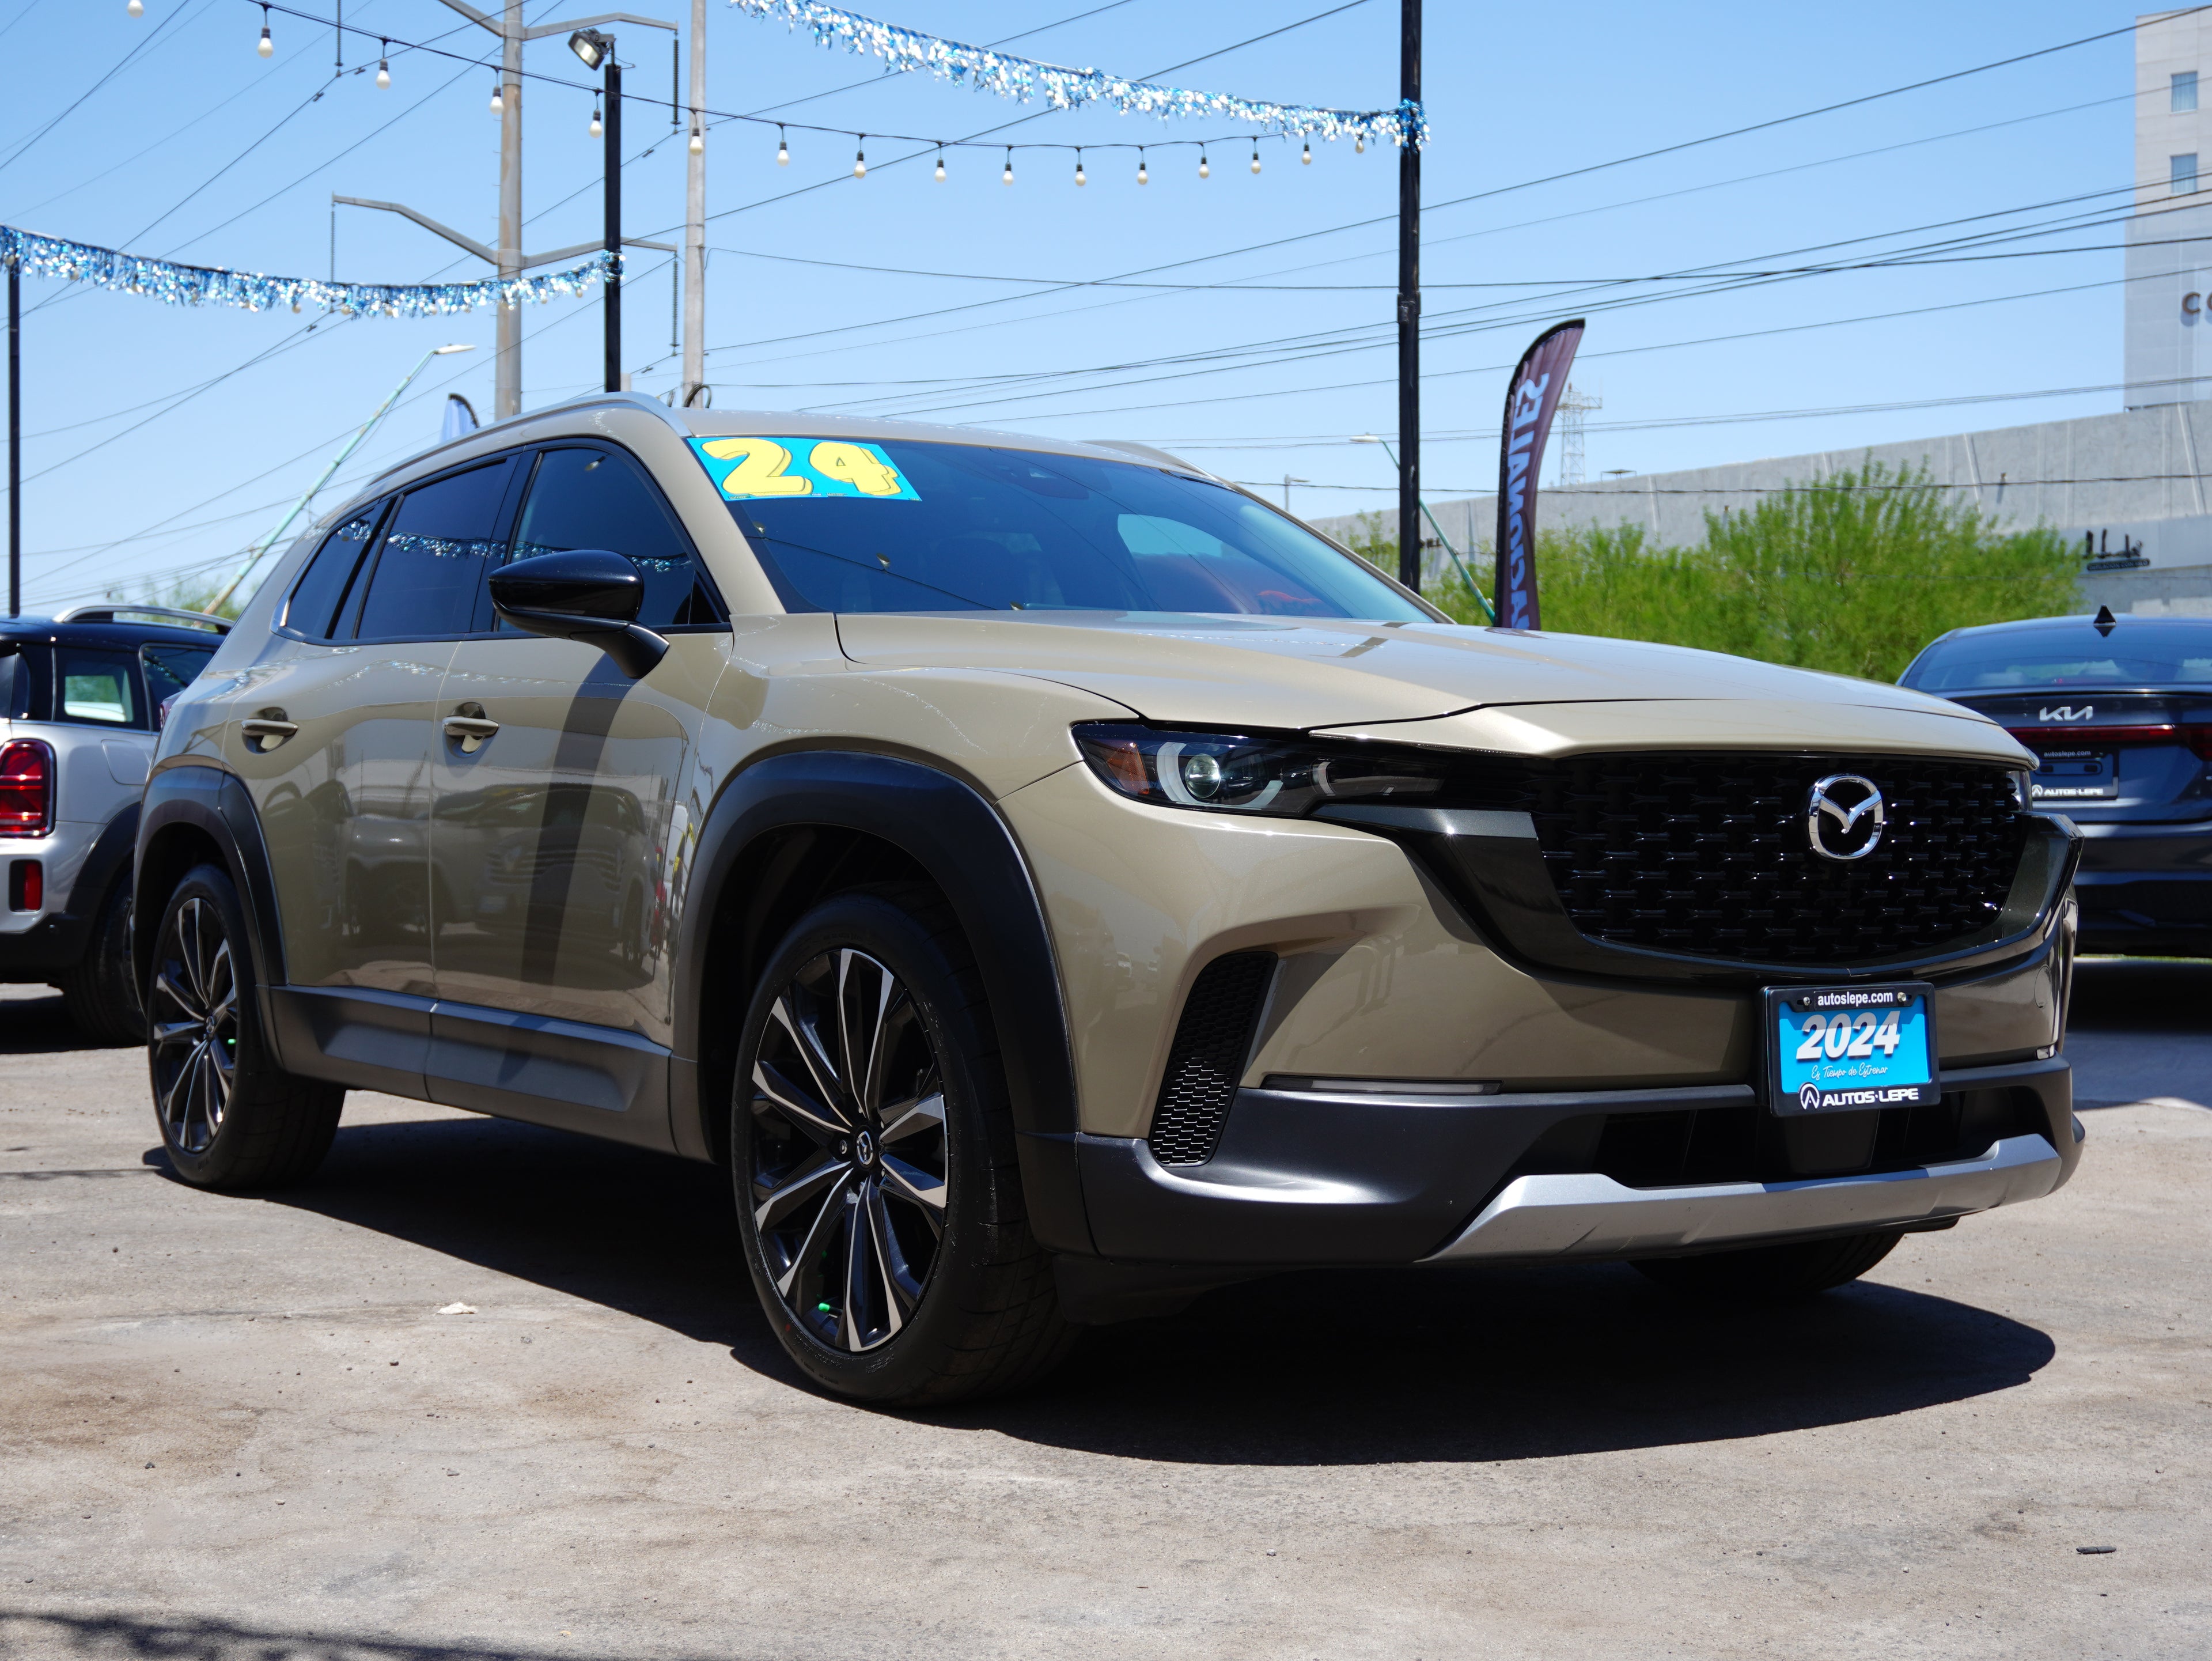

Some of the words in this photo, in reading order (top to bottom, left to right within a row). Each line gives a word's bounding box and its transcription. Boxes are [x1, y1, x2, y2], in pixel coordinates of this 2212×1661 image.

[701, 438, 903, 496] 24
[2039, 706, 2093, 721] KIA
[1817, 991, 1893, 1007] autoslepe.com
[1796, 1010, 1901, 1061] 2024
[1811, 1065, 1820, 1080] Es
[1822, 1065, 1847, 1079] Tiempo
[1848, 1065, 1858, 1077] de
[1858, 1062, 1888, 1076] Estrenar
